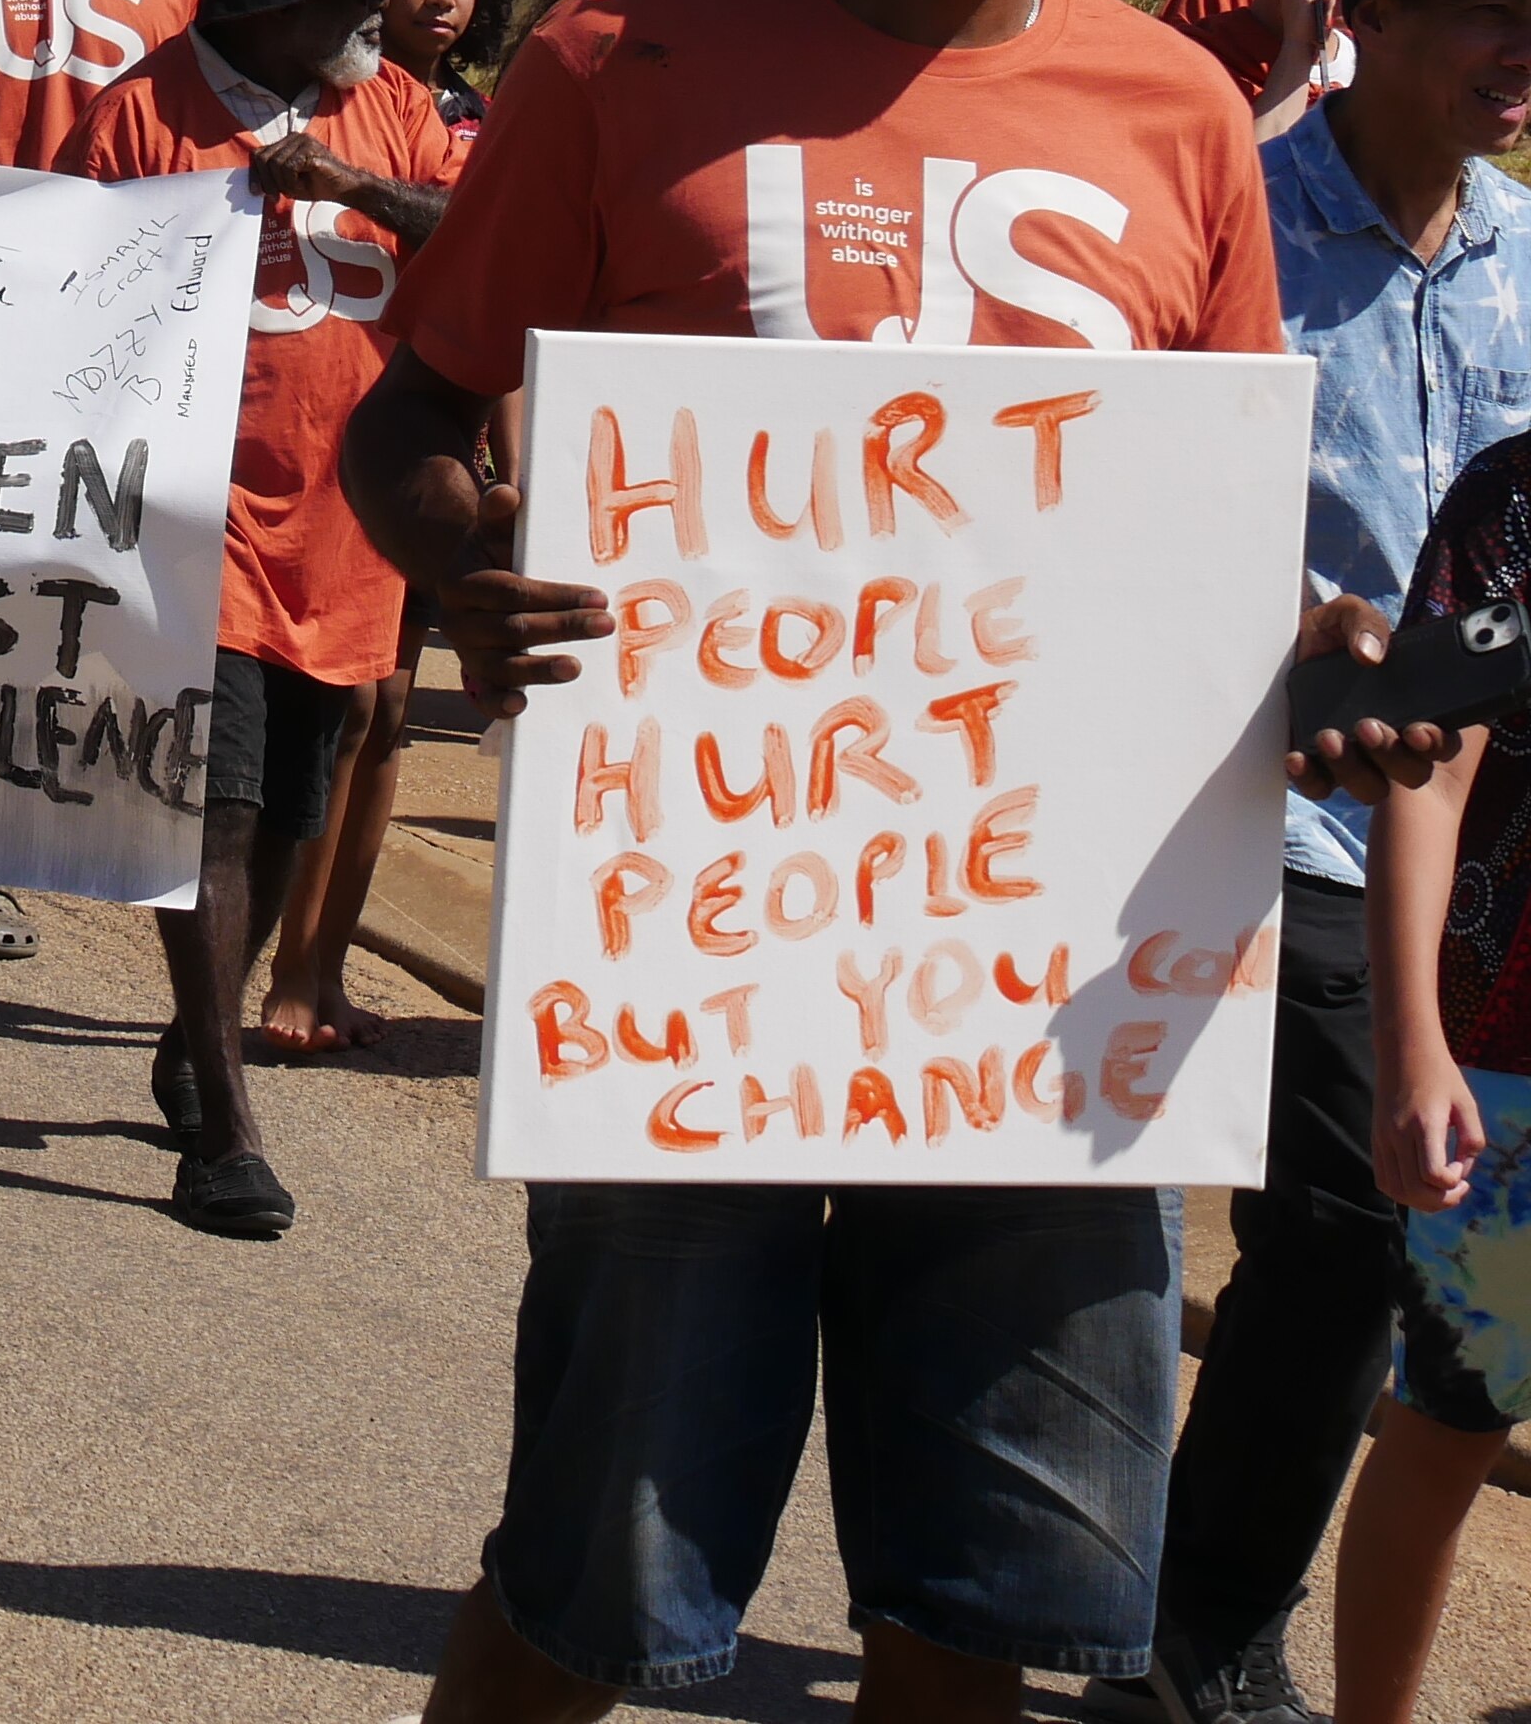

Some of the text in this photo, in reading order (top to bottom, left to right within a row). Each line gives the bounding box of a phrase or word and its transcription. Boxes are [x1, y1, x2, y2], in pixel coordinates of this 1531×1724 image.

[268, 219, 278, 229] is
[815, 200, 913, 225] stronger
[820, 222, 908, 248] without
[855, 177, 874, 197] is
[171, 235, 213, 312] Edward
[832, 246, 898, 268] abuse
[585, 389, 1102, 566] HURT
[614, 574, 1039, 701] PEOPLE
[573, 680, 1019, 844] HURT
[591, 783, 1046, 962] PEOPLE
[528, 980, 760, 1087] BUT
[836, 938, 1072, 1062] YOU
[644, 1020, 1170, 1155] CHANGE
